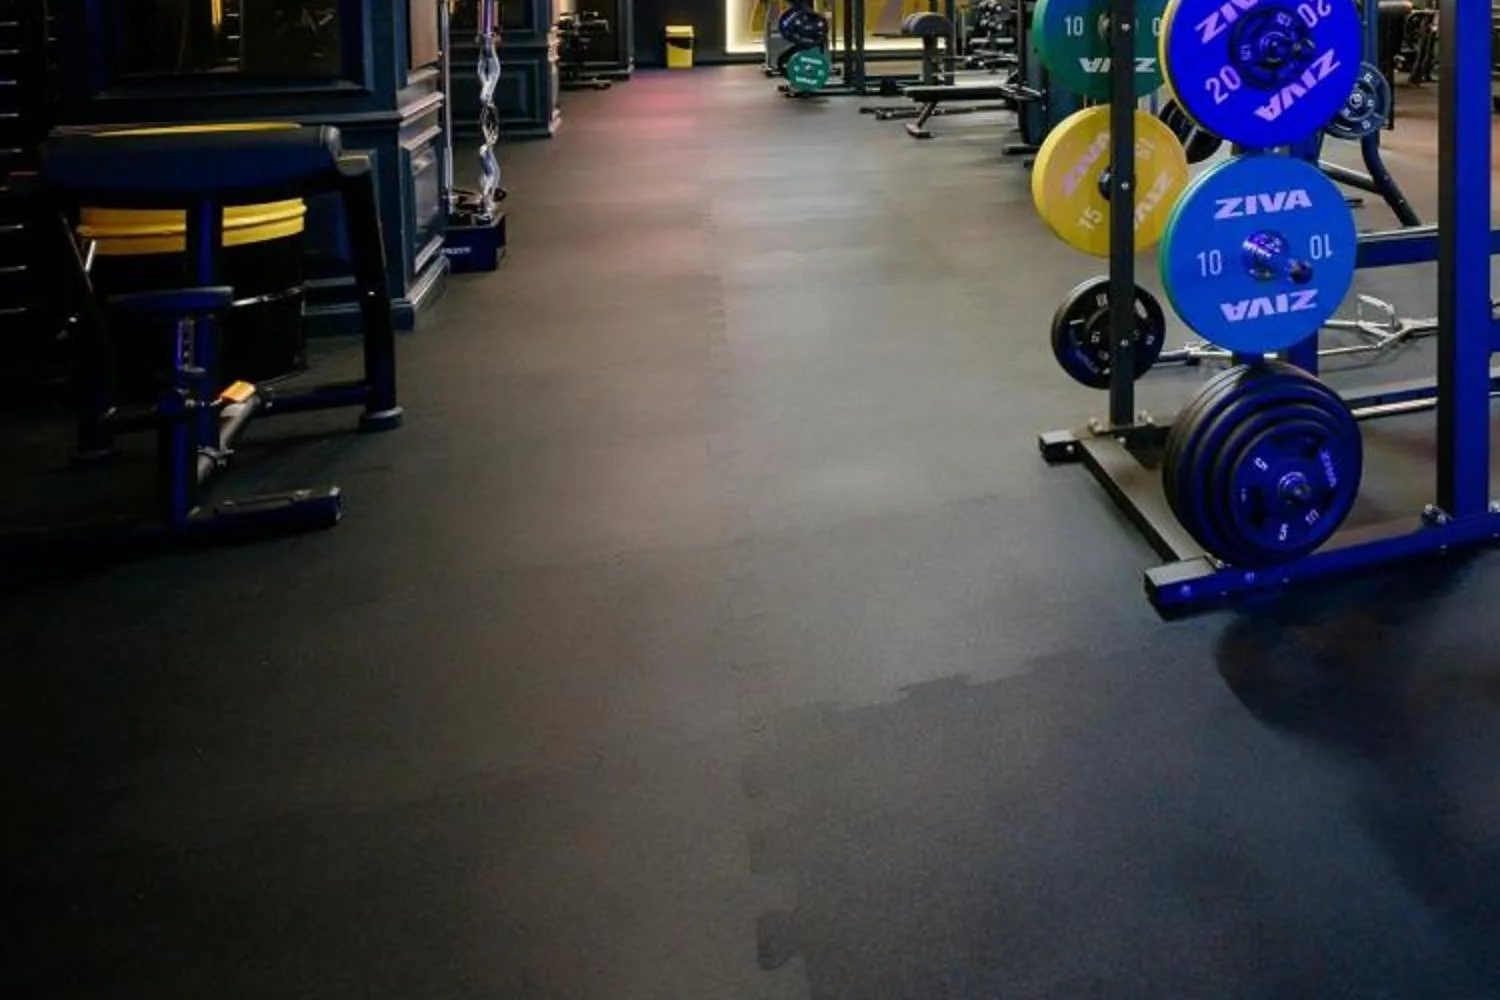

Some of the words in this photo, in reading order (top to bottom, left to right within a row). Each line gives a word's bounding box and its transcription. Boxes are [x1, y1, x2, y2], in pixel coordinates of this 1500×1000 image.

[1064, 16, 1084, 36] 10
[1079, 57, 1157, 73] ZA
[1205, 65, 1242, 105] 20
[1253, 48, 1341, 122] ZIVA
[1076, 206, 1103, 231] 15
[1213, 189, 1313, 220] ZIVA
[1309, 233, 1333, 260] 10
[1196, 249, 1223, 277] 10
[1220, 288, 1319, 322] ZIVA
